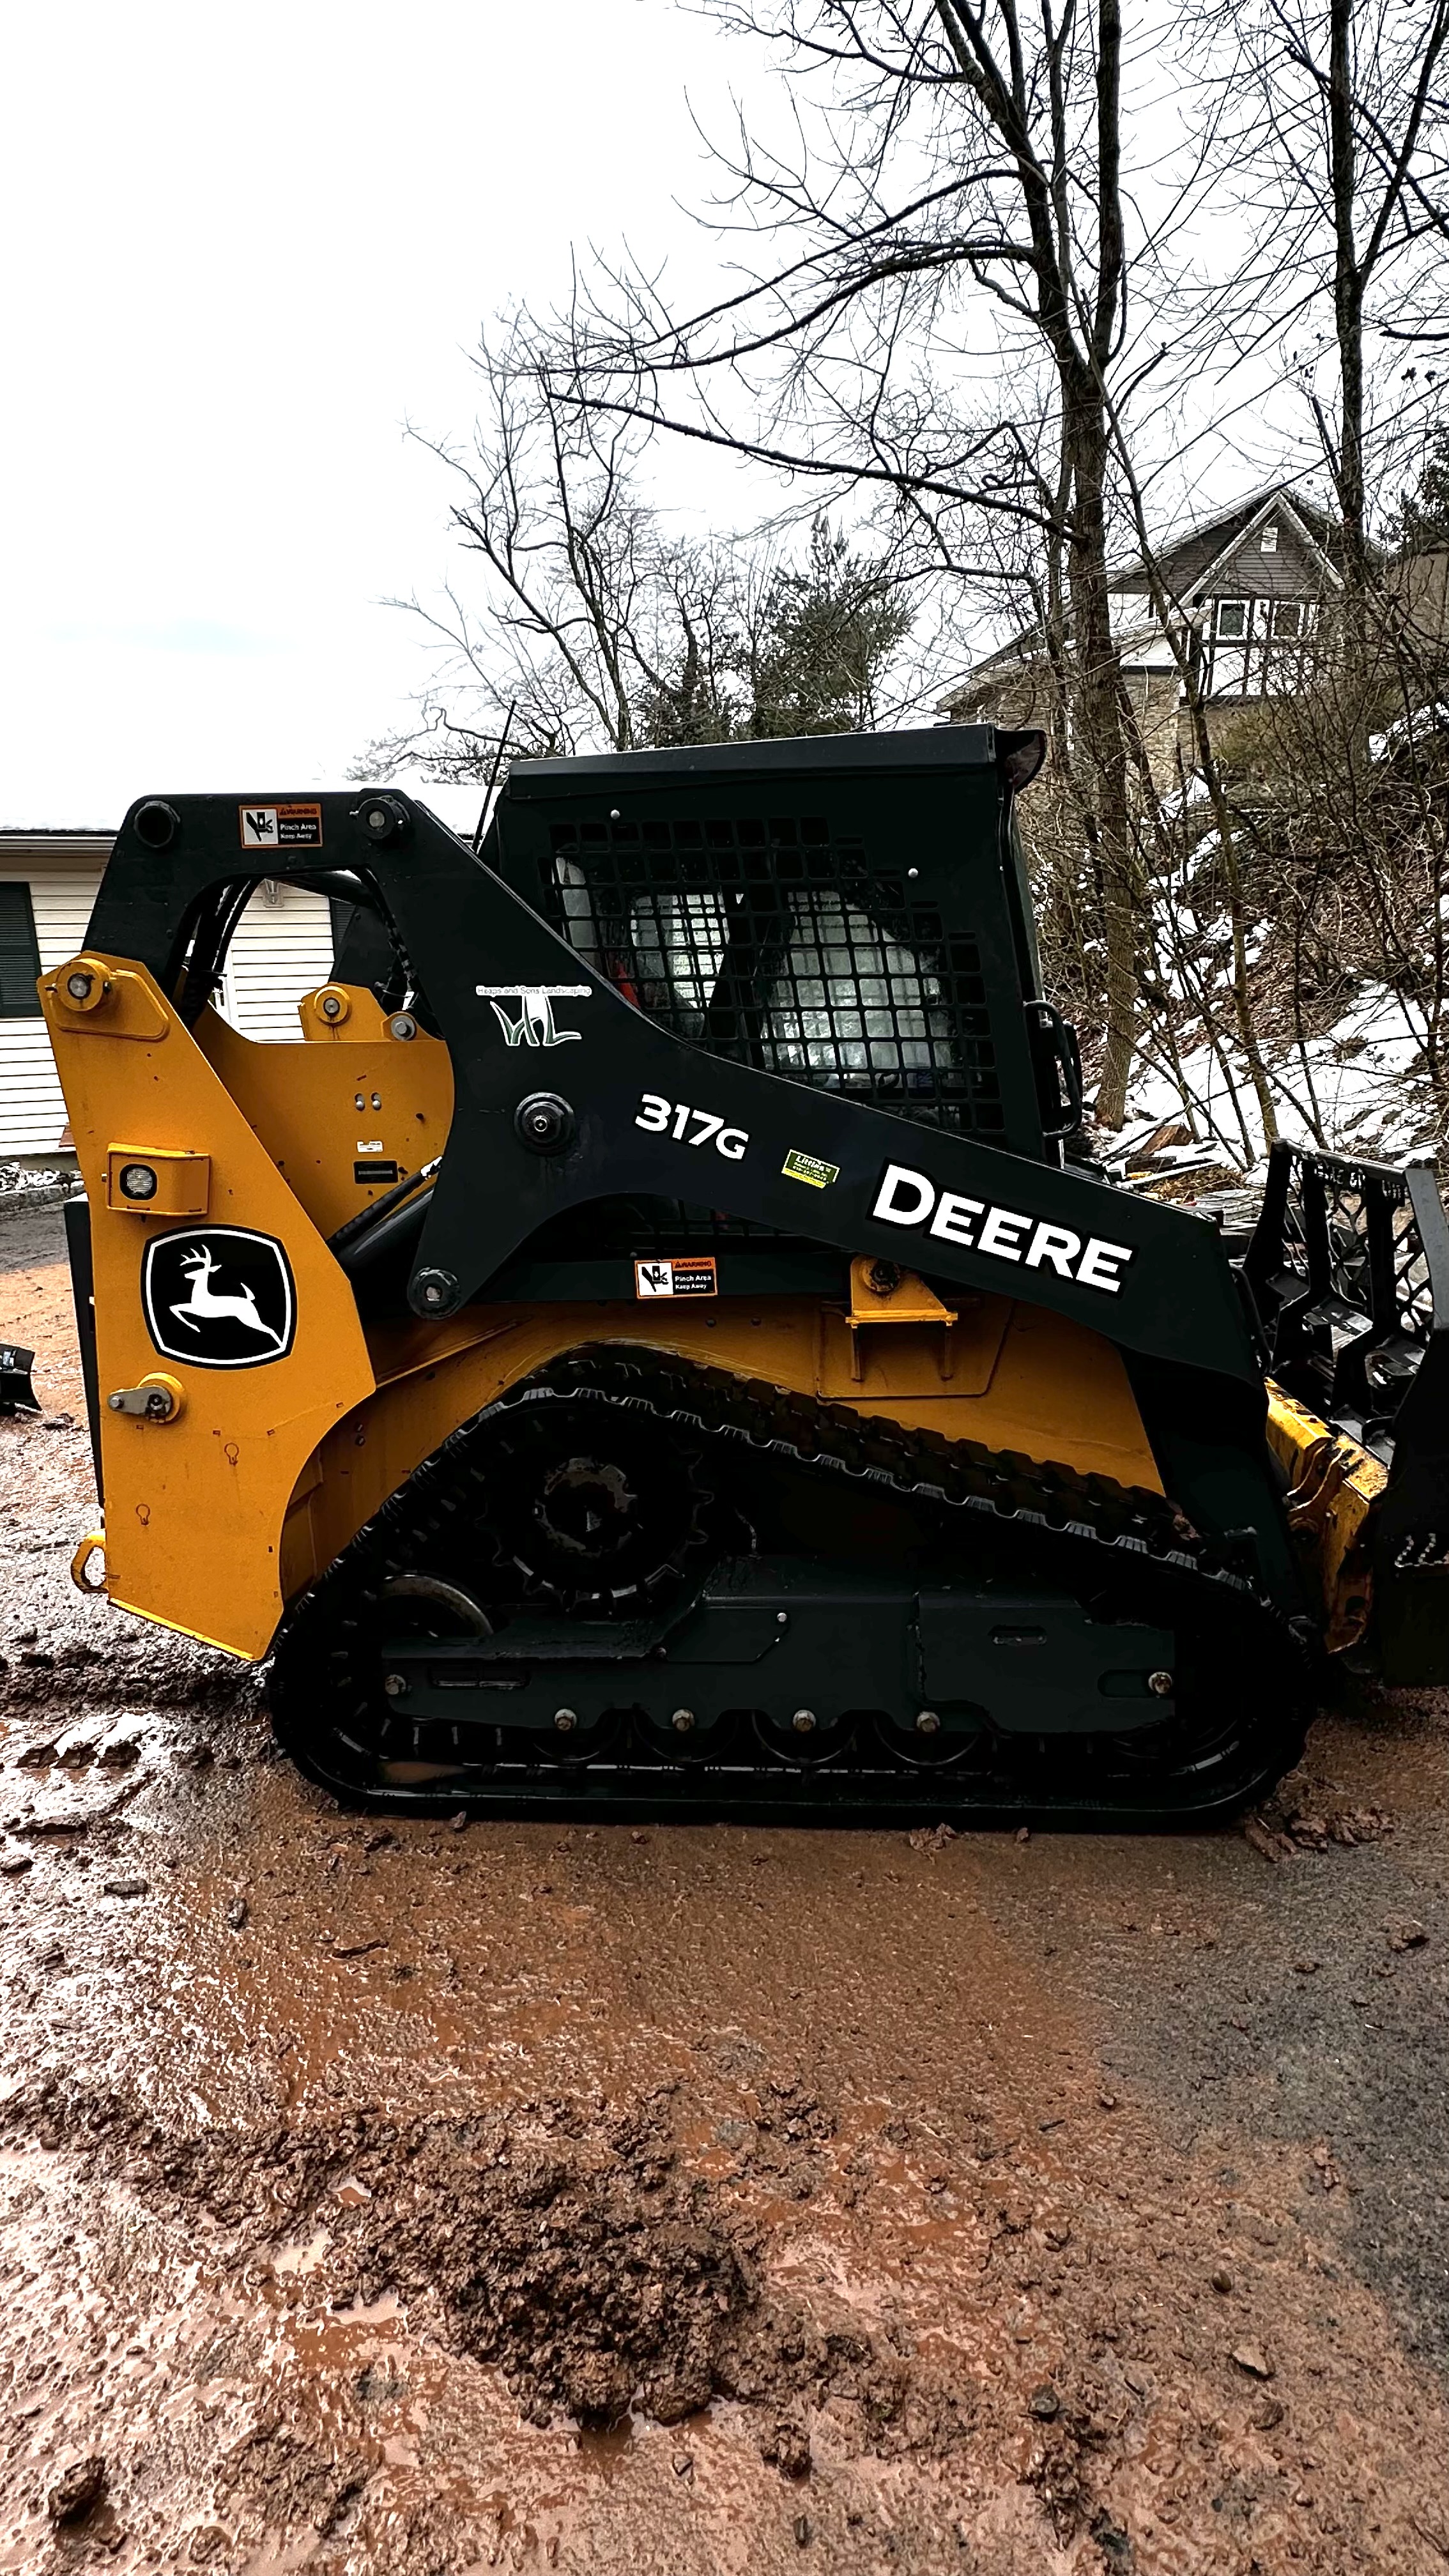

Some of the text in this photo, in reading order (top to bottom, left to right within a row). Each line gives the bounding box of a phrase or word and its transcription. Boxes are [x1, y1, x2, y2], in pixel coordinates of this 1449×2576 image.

[542, 986, 590, 995] Landscaping
[635, 1094, 749, 1160] 317G
[873, 1164, 1132, 1292] DEERE
